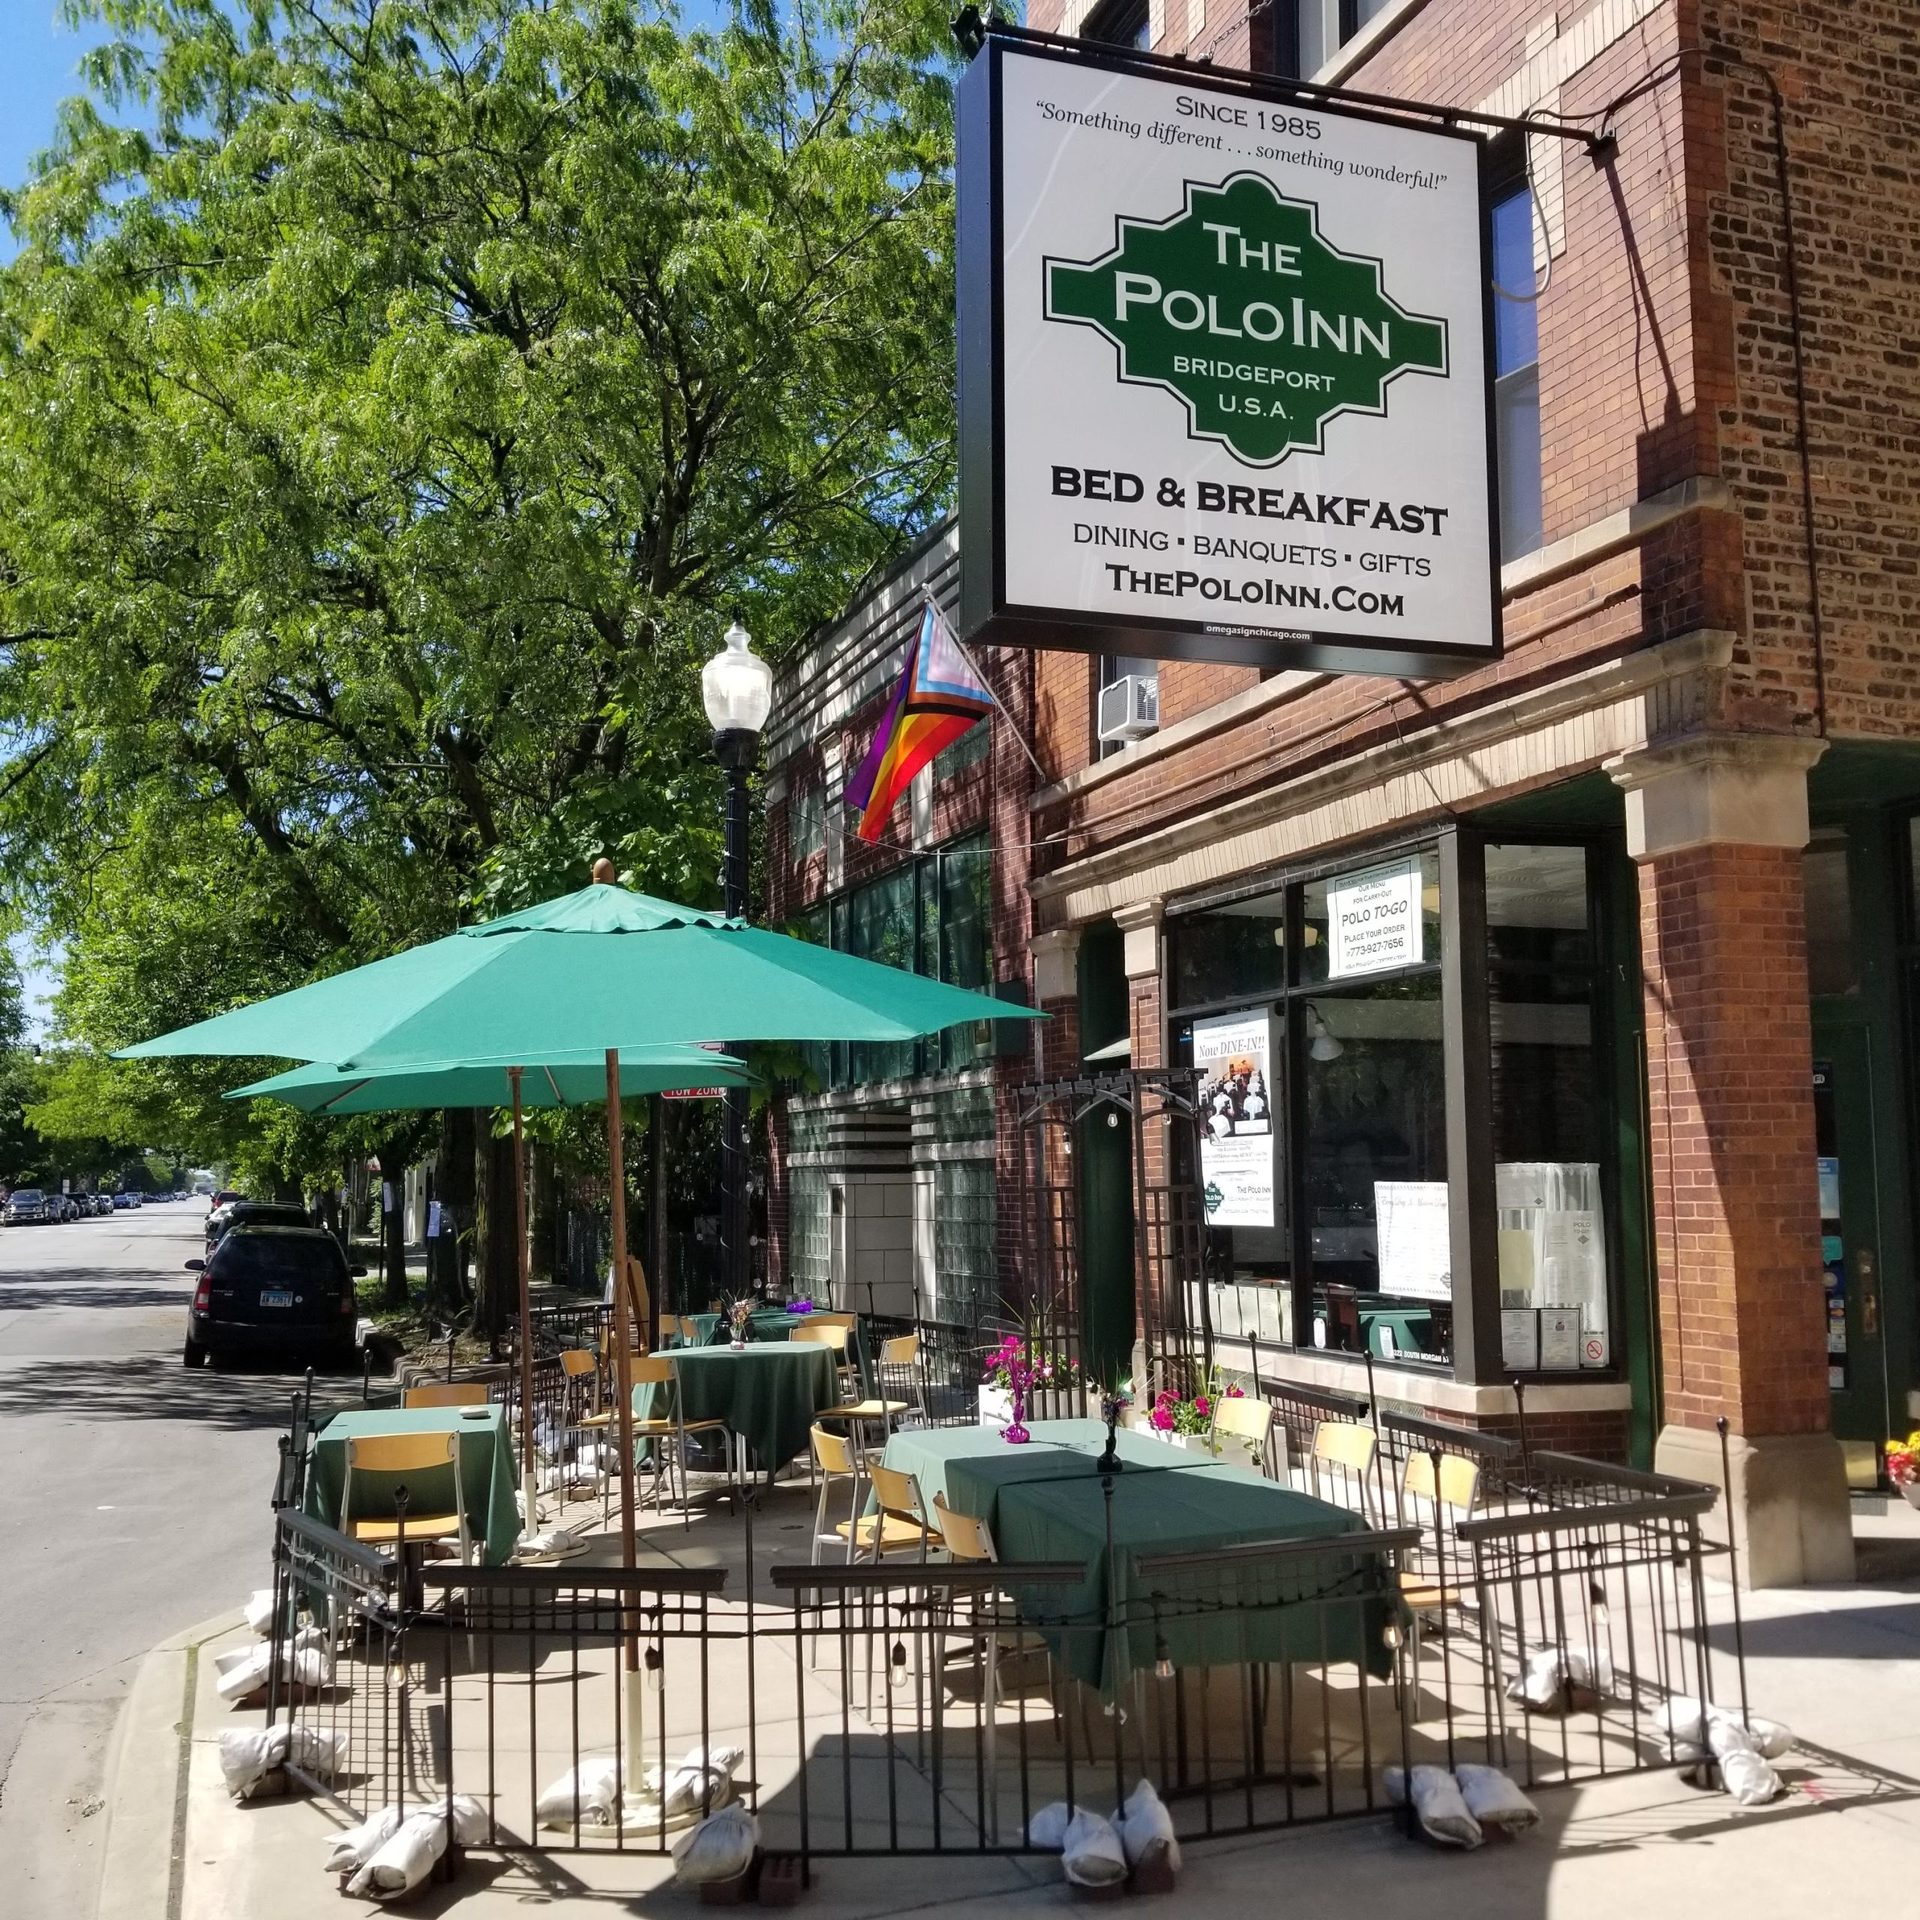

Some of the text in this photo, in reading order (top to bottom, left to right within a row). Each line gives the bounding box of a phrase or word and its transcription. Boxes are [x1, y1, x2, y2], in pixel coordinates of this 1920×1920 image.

[1176, 95, 1322, 139] SINCE 1985
[1147, 121, 1223, 150] different
[1256, 145, 1344, 175] something
[1203, 221, 1302, 276] THE
[1174, 355, 1335, 392] BRIDGEPORT
[1218, 394, 1294, 420] U.S.A.
[1051, 465, 1448, 536] BED & BREAKFAST
[1074, 523, 1431, 576] DINING BANQUETS GIFTS
[1206, 625, 1310, 640] omegasignchicago.com
[1342, 900, 1408, 927] POLO TO-GO
[1344, 924, 1405, 943] PLACE YOUR ORDER
[1220, 1036, 1265, 1055] DINE-IN!!
[1247, 1186, 1261, 1194] POLO
